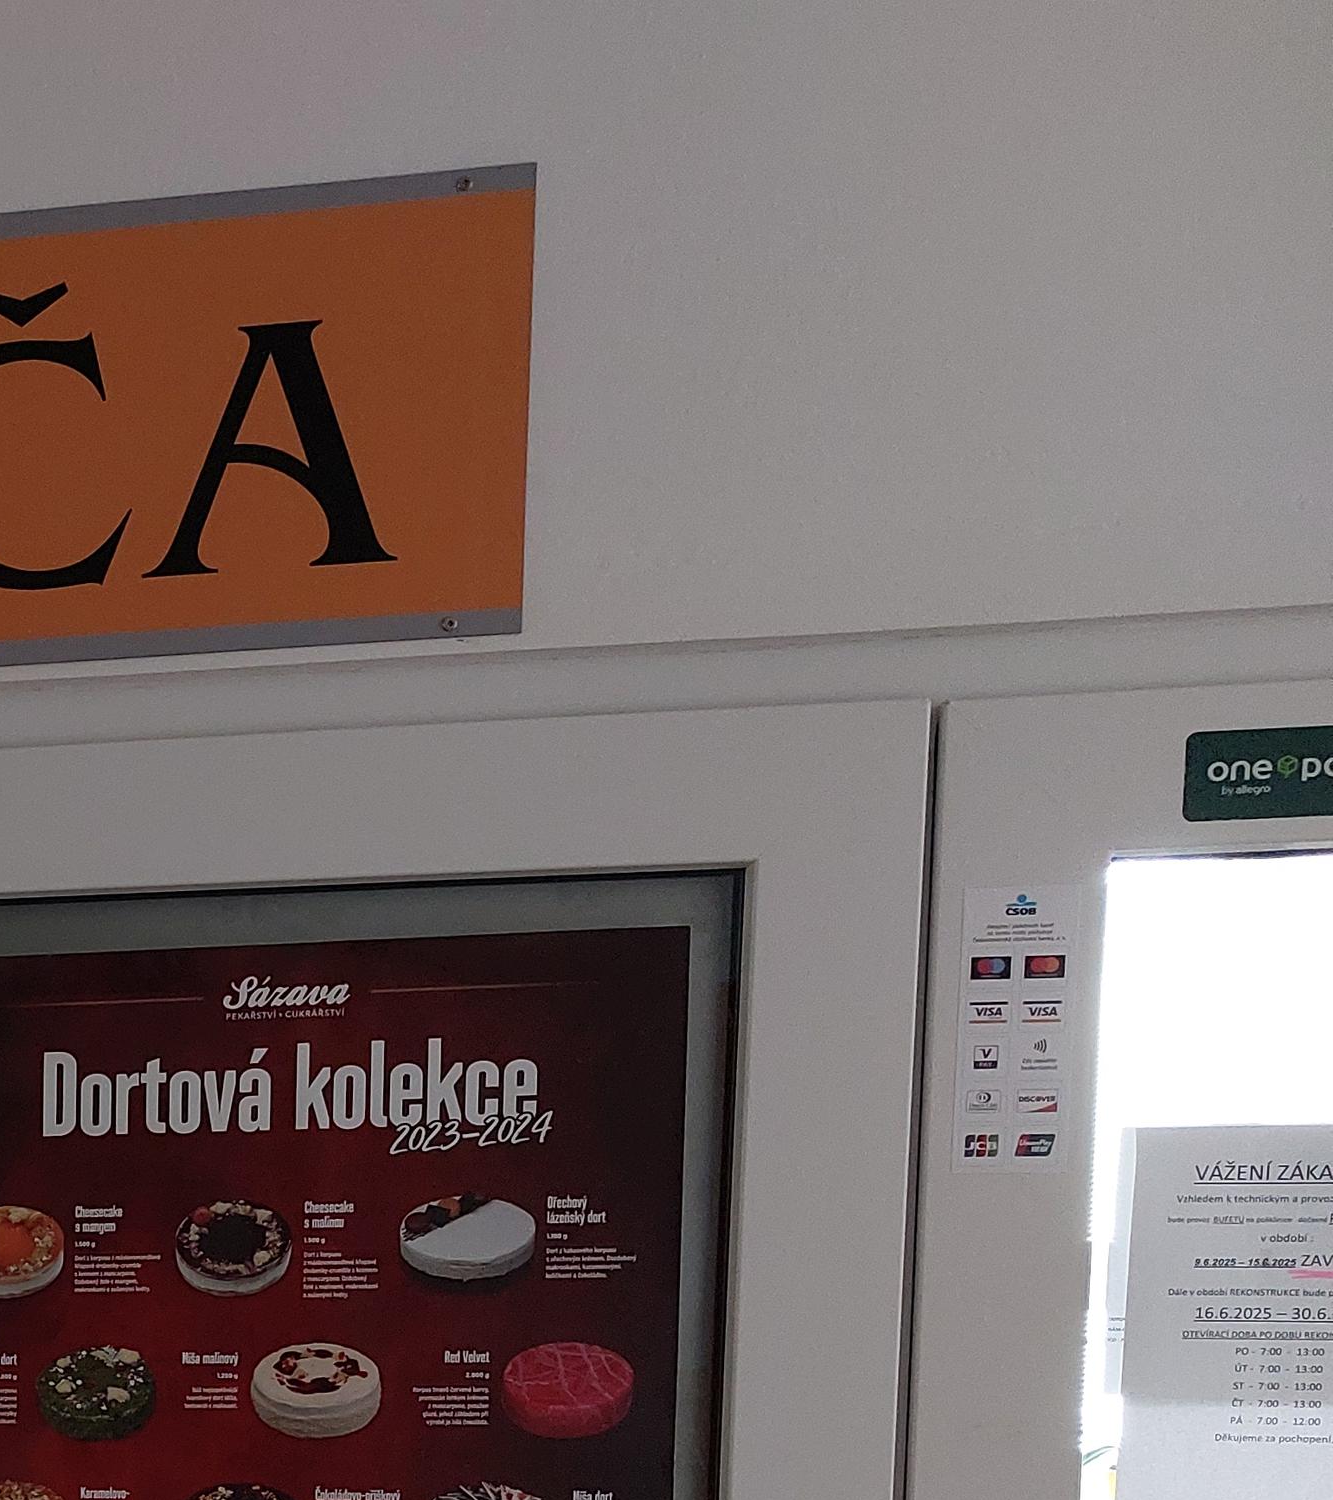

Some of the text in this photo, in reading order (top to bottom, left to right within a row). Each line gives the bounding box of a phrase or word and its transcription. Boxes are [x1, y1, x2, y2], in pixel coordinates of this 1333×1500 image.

[1207, 758, 1274, 783] one
[1235, 784, 1272, 797] allegro
[222, 974, 352, 1010] Sázava
[975, 1006, 1058, 1017] VISA VISA
[42, 1037, 539, 1138] Dortová kolekce
[1194, 1159, 1333, 1182] VÁŽENÍ ZÁKA
[546, 1194, 588, 1212] Ořechový
[1176, 1194, 1224, 1204] Vzhledem
[1234, 1193, 1290, 1205] technickým
[303, 1200, 355, 1214] Cheesecake
[586, 1209, 607, 1224] dort
[1213, 1215, 1245, 1224] BUFETU
[1269, 1233, 1308, 1243] období
[1167, 1287, 1188, 1297] Dále
[1196, 1287, 1228, 1297] období
[1229, 1287, 1301, 1297] REKONSTRUKCE
[1302, 1287, 1327, 1297] bude
[1194, 1306, 1272, 1320] 16.6.2025
[1182, 1329, 1230, 1339] OTEVÍRACÍ
[1259, 1331, 1273, 1339] PO
[443, 1350, 491, 1364] Red Velvet
[1235, 1347, 1325, 1357] PO 7:00 13:00
[0, 1353, 18, 1366] dort
[1234, 1364, 1324, 1374] ÚT 7:00 13:00
[1232, 1382, 1323, 1392] ST 7:00 13:00
[1231, 1398, 1322, 1409] ČT 7:00 13:00
[1230, 1415, 1321, 1426] PÁ 7:00 12:00
[1214, 1433, 1262, 1444] Děkujeme
[1265, 1435, 1276, 1443] za
